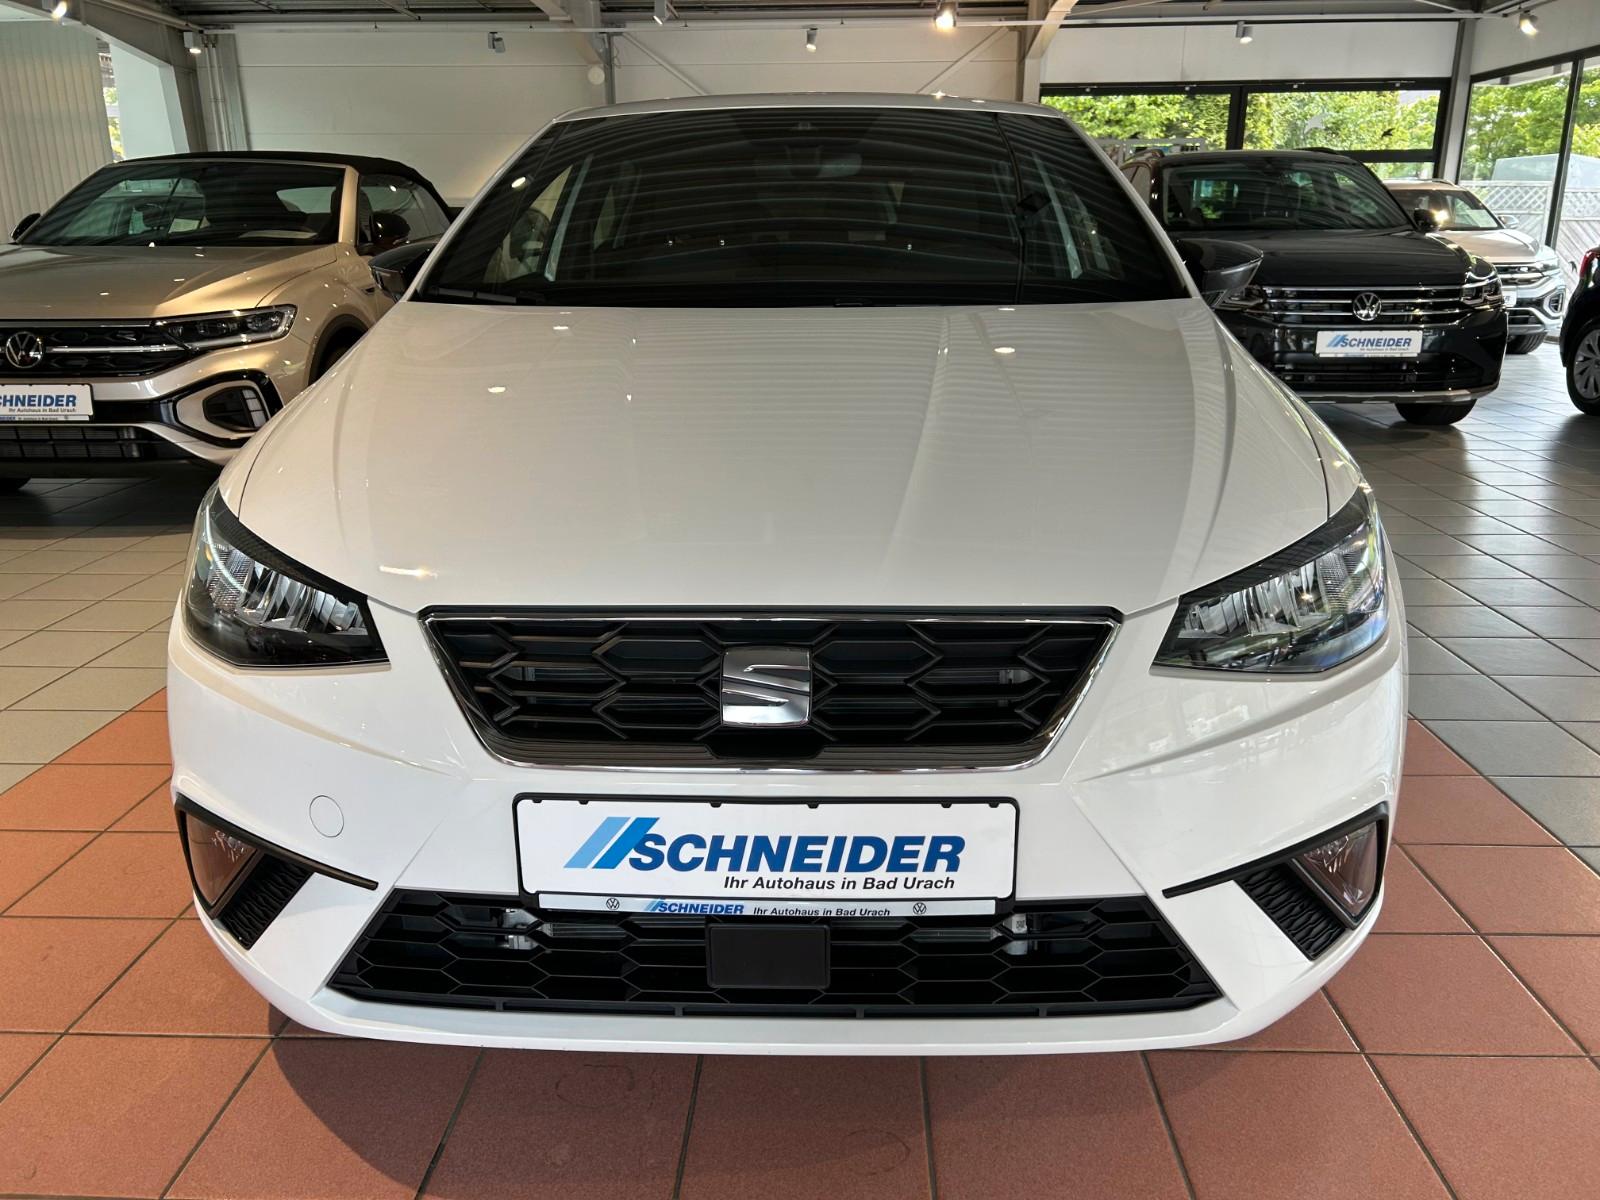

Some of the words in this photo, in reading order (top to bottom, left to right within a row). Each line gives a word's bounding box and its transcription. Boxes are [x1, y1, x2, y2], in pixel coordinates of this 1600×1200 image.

[1340, 337, 1412, 348] SCHNEIDER
[0, 394, 77, 407] HNEIDER
[628, 832, 966, 873] SCHNEIDER
[723, 876, 749, 889] Ihr
[752, 876, 836, 890] Autohaus
[840, 877, 857, 890] in
[862, 877, 899, 890] Bad
[903, 876, 955, 890] Urach
[657, 902, 745, 915] SCHNEIDER
[753, 907, 768, 915] Ihr
[770, 907, 820, 916] Autohaus
[822, 907, 833, 916] in
[835, 907, 857, 917] Bad
[859, 908, 891, 916] Urach
